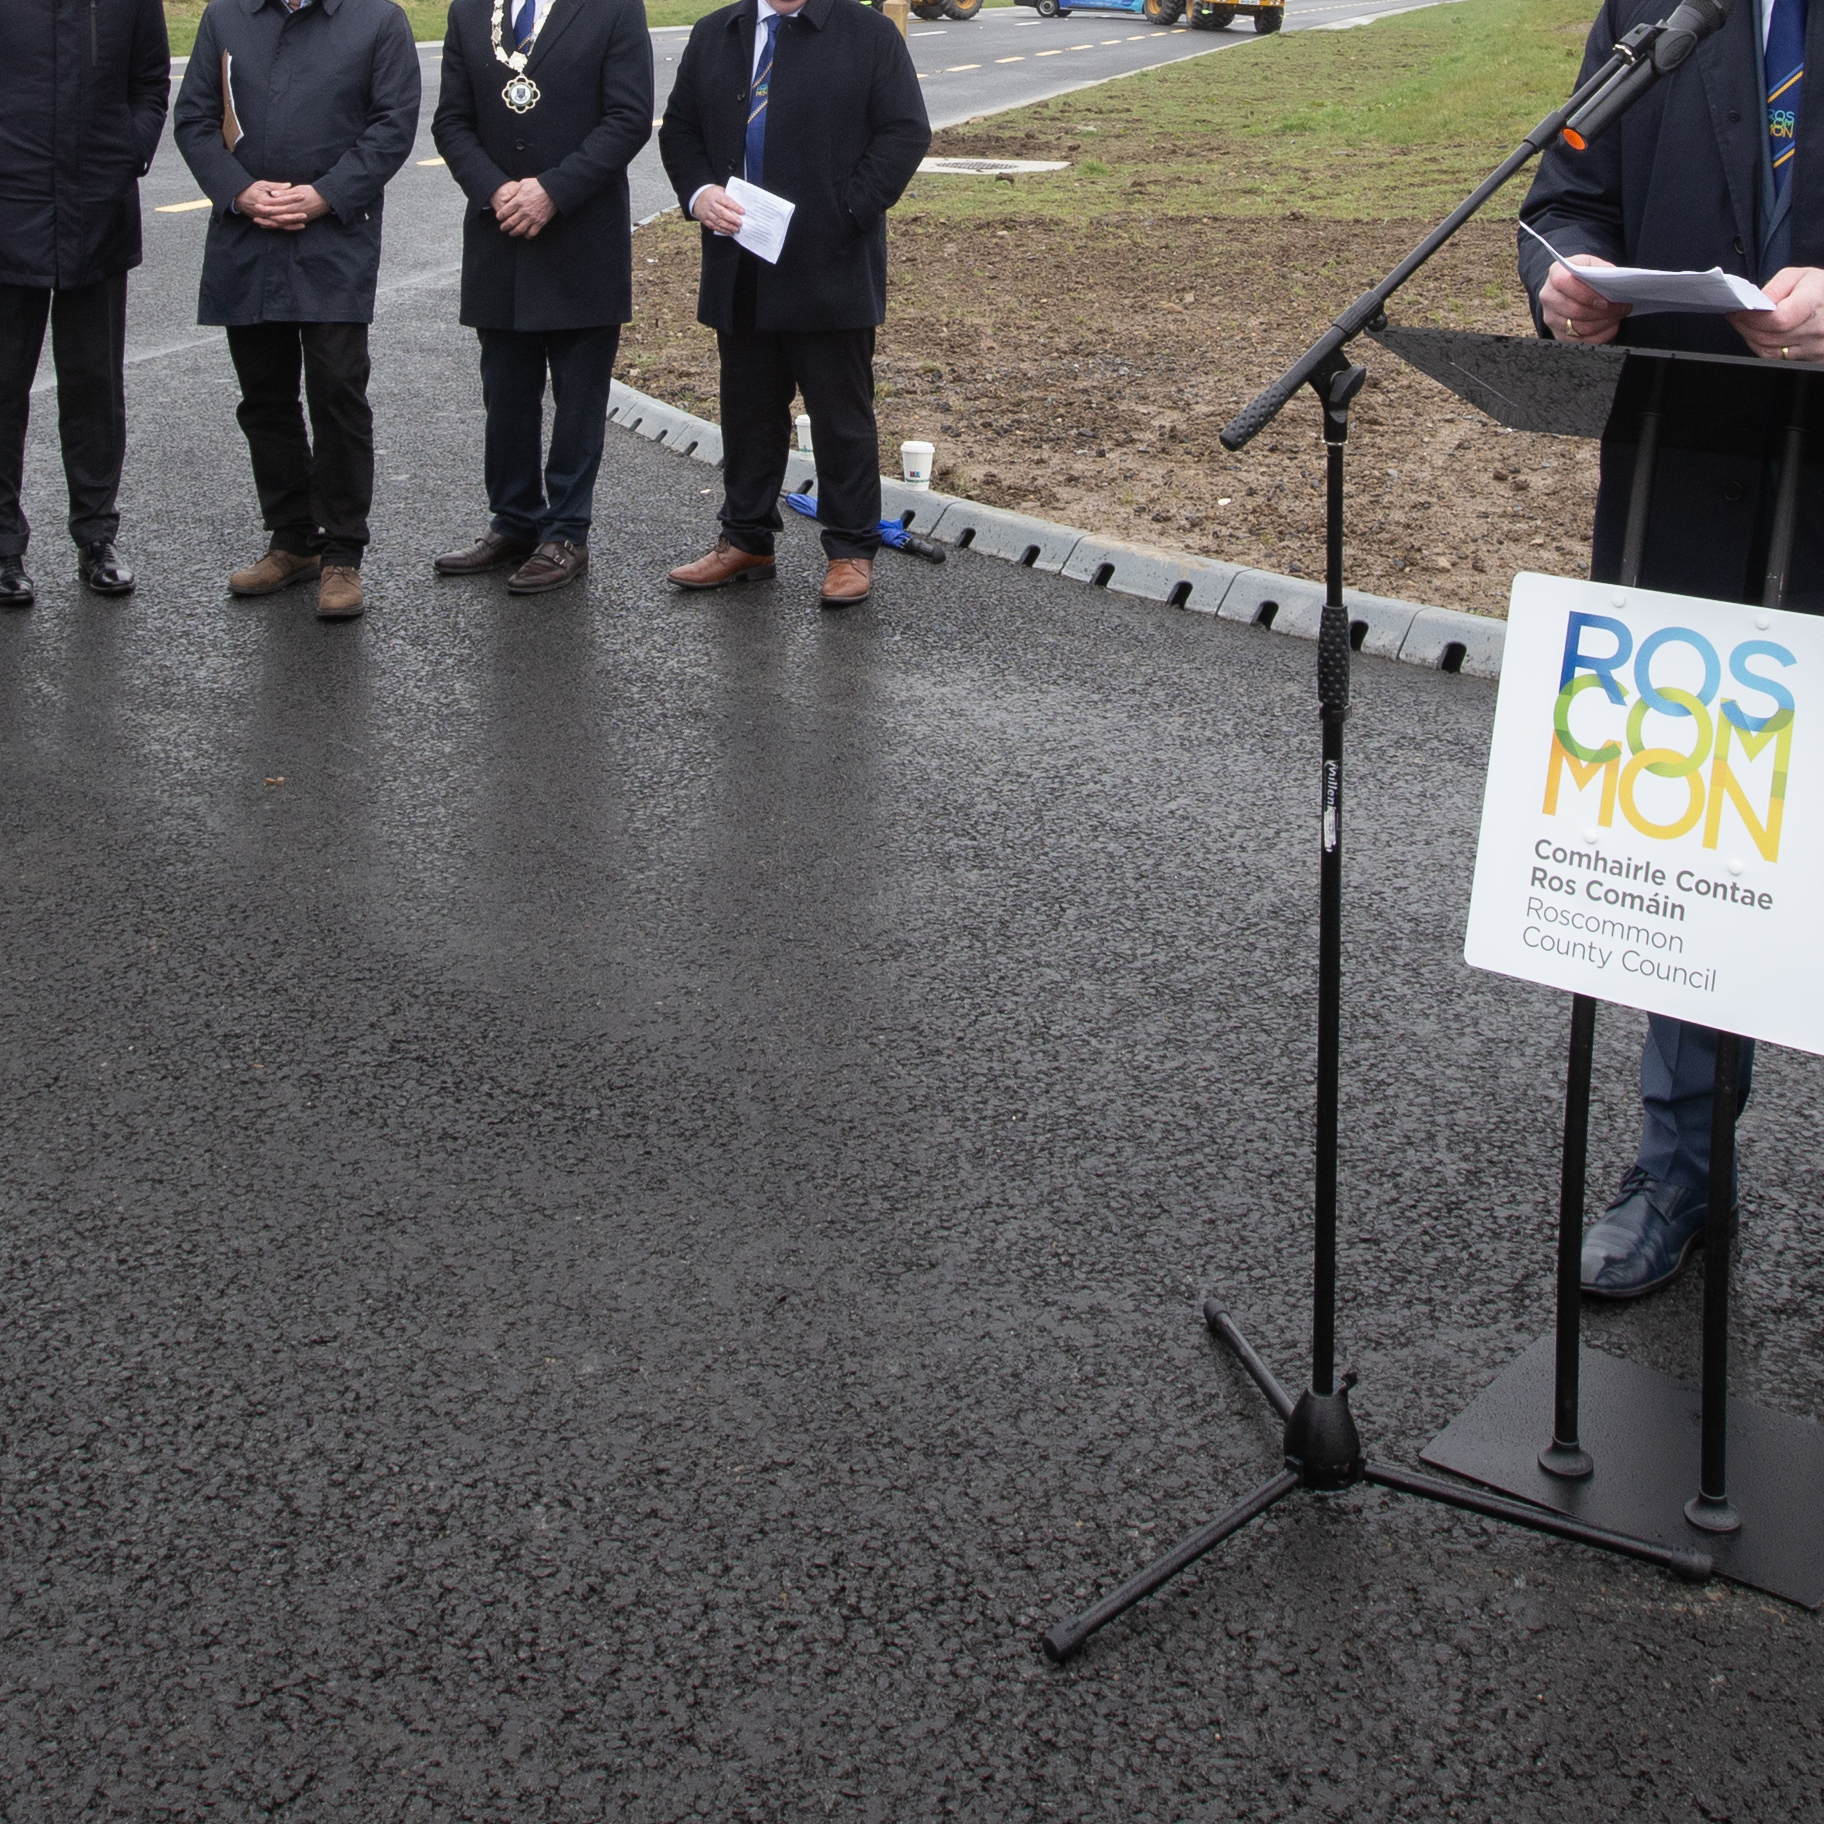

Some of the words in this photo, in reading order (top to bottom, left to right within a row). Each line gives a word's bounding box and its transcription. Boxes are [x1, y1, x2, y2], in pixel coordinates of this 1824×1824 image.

[1559, 610, 1798, 733] ROS
[1553, 673, 1795, 799] COM
[1542, 728, 1788, 863] MON
[1530, 866, 1576, 896] Ros
[1585, 878, 1686, 922] Comáin
[1533, 838, 1667, 887] Comhairle
[1675, 869, 1774, 911] Contae
[1522, 926, 1612, 970] County
[1621, 949, 1717, 993] Council
[1525, 896, 1684, 954] Roscommon
